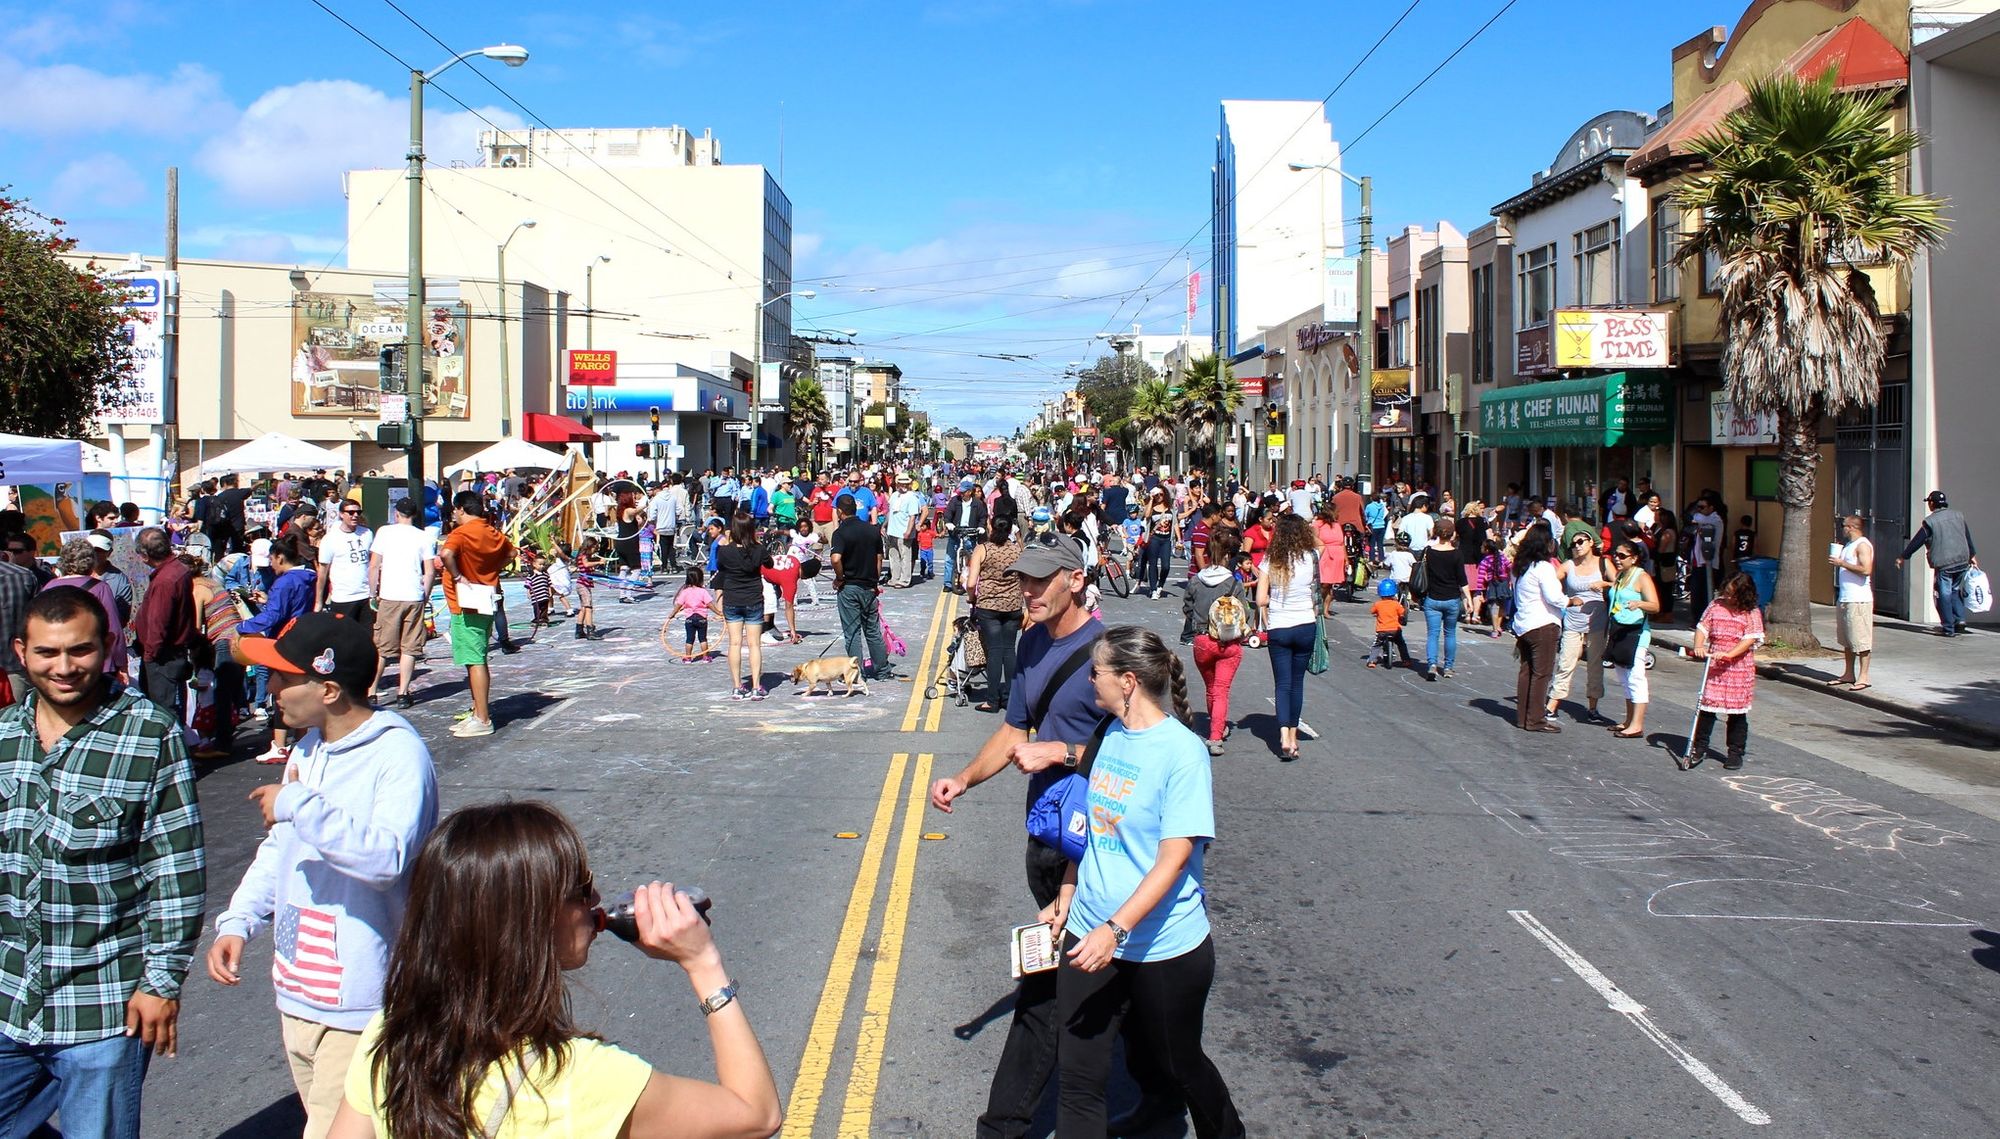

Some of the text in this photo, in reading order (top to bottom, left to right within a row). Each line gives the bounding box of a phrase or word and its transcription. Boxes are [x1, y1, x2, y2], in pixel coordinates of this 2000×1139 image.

[362, 325, 403, 333] OCEAN
[1603, 318, 1652, 338] PASS
[573, 353, 611, 362] WELLS
[1601, 340, 1657, 359] TIME
[574, 362, 611, 370] FARGO
[567, 393, 617, 409] tibank
[1524, 393, 1599, 418] CHEF HUNAN
[1615, 404, 1665, 412] CHEF HUNAN
[1585, 415, 1599, 426] 4661
[1731, 418, 1759, 437] TIME
[1739, 541, 1748, 552] 3
[1106, 764, 1138, 780] FRANCISCO
[1091, 768, 1136, 800] HALF
[1091, 805, 1124, 837] 5K
